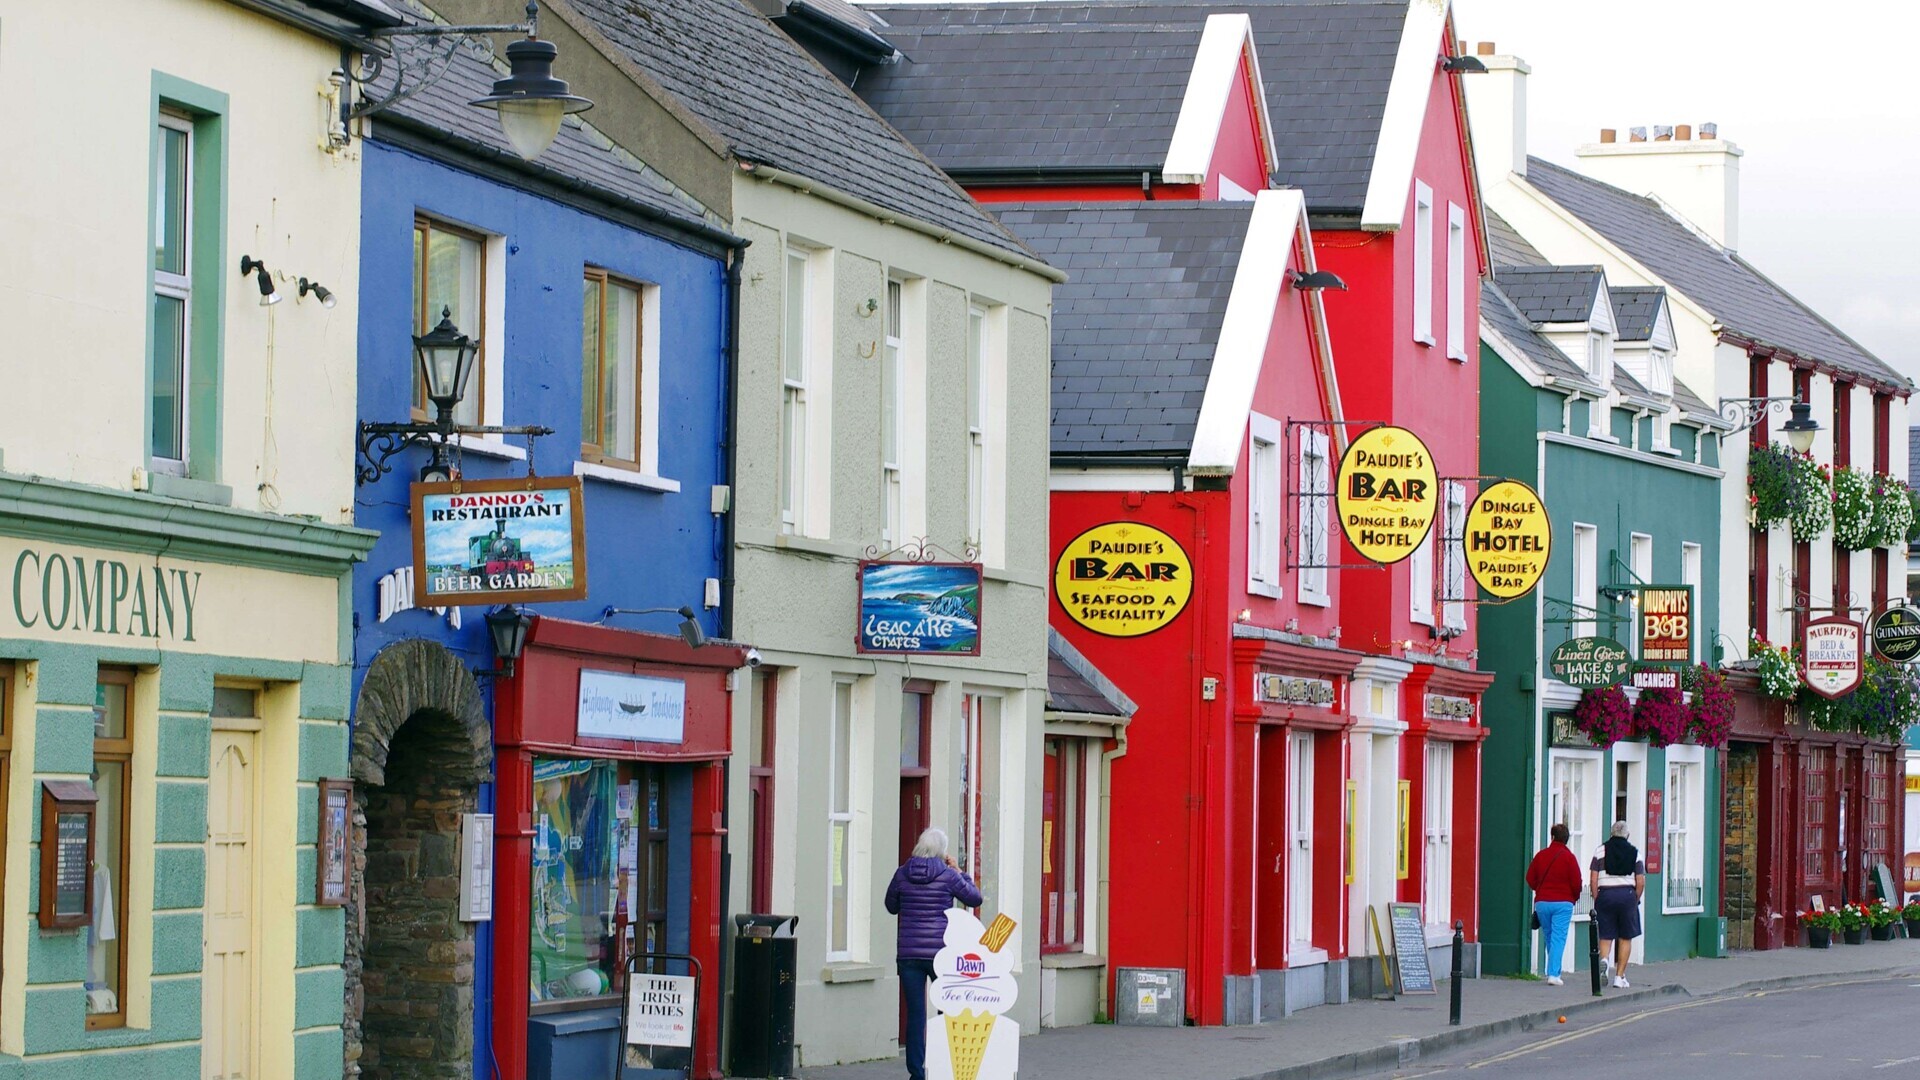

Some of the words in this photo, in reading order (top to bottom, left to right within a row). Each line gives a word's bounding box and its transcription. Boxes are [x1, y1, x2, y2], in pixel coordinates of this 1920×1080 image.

[1355, 450, 1423, 469] PAUDIE'S
[1348, 472, 1427, 502] BAR
[450, 493, 544, 508] DANNO'S
[1481, 500, 1535, 514] DINGLE
[432, 504, 563, 521] RESTAURANT
[1348, 514, 1395, 527] DINGLE
[1399, 516, 1425, 528] BAY
[1491, 516, 1523, 530] BAY
[1359, 529, 1412, 547] HOTEL
[1471, 531, 1544, 552] HOTEL
[1089, 540, 1164, 555] PAUDIE'S
[1069, 557, 1179, 582] BAR
[1477, 561, 1538, 574] PAUDIE'S
[434, 575, 482, 591] BEER
[489, 571, 567, 589] GARDEN
[1491, 576, 1523, 588] BAR
[13, 548, 201, 642] COMPANY
[1071, 592, 1155, 605] SEAFOOD
[1163, 595, 1176, 605] A
[1644, 590, 1687, 613] MURPHYS
[1081, 607, 1166, 620] SPECIALITY
[1644, 615, 1688, 640] B&B
[1809, 626, 1856, 640] MURPHY'S
[1876, 625, 1920, 638] GUINNESS
[1576, 639, 1594, 651] The
[1820, 640, 1836, 649] BED
[1839, 640, 1845, 649] &
[1557, 647, 1591, 660] Linen
[1594, 646, 1626, 663] Chest
[1809, 650, 1856, 660] BREAKFAST
[1567, 662, 1602, 674] LACE
[1604, 661, 1614, 673] &
[1569, 673, 1611, 684] LINEN
[1633, 673, 1676, 688] VACANCIES
[956, 956, 985, 973] Dawn
[648, 980, 677, 991] THE
[642, 992, 681, 1004] IRISH
[942, 990, 961, 1001] Ice
[964, 990, 1000, 1003] Cream
[639, 1004, 684, 1017] TIMES
